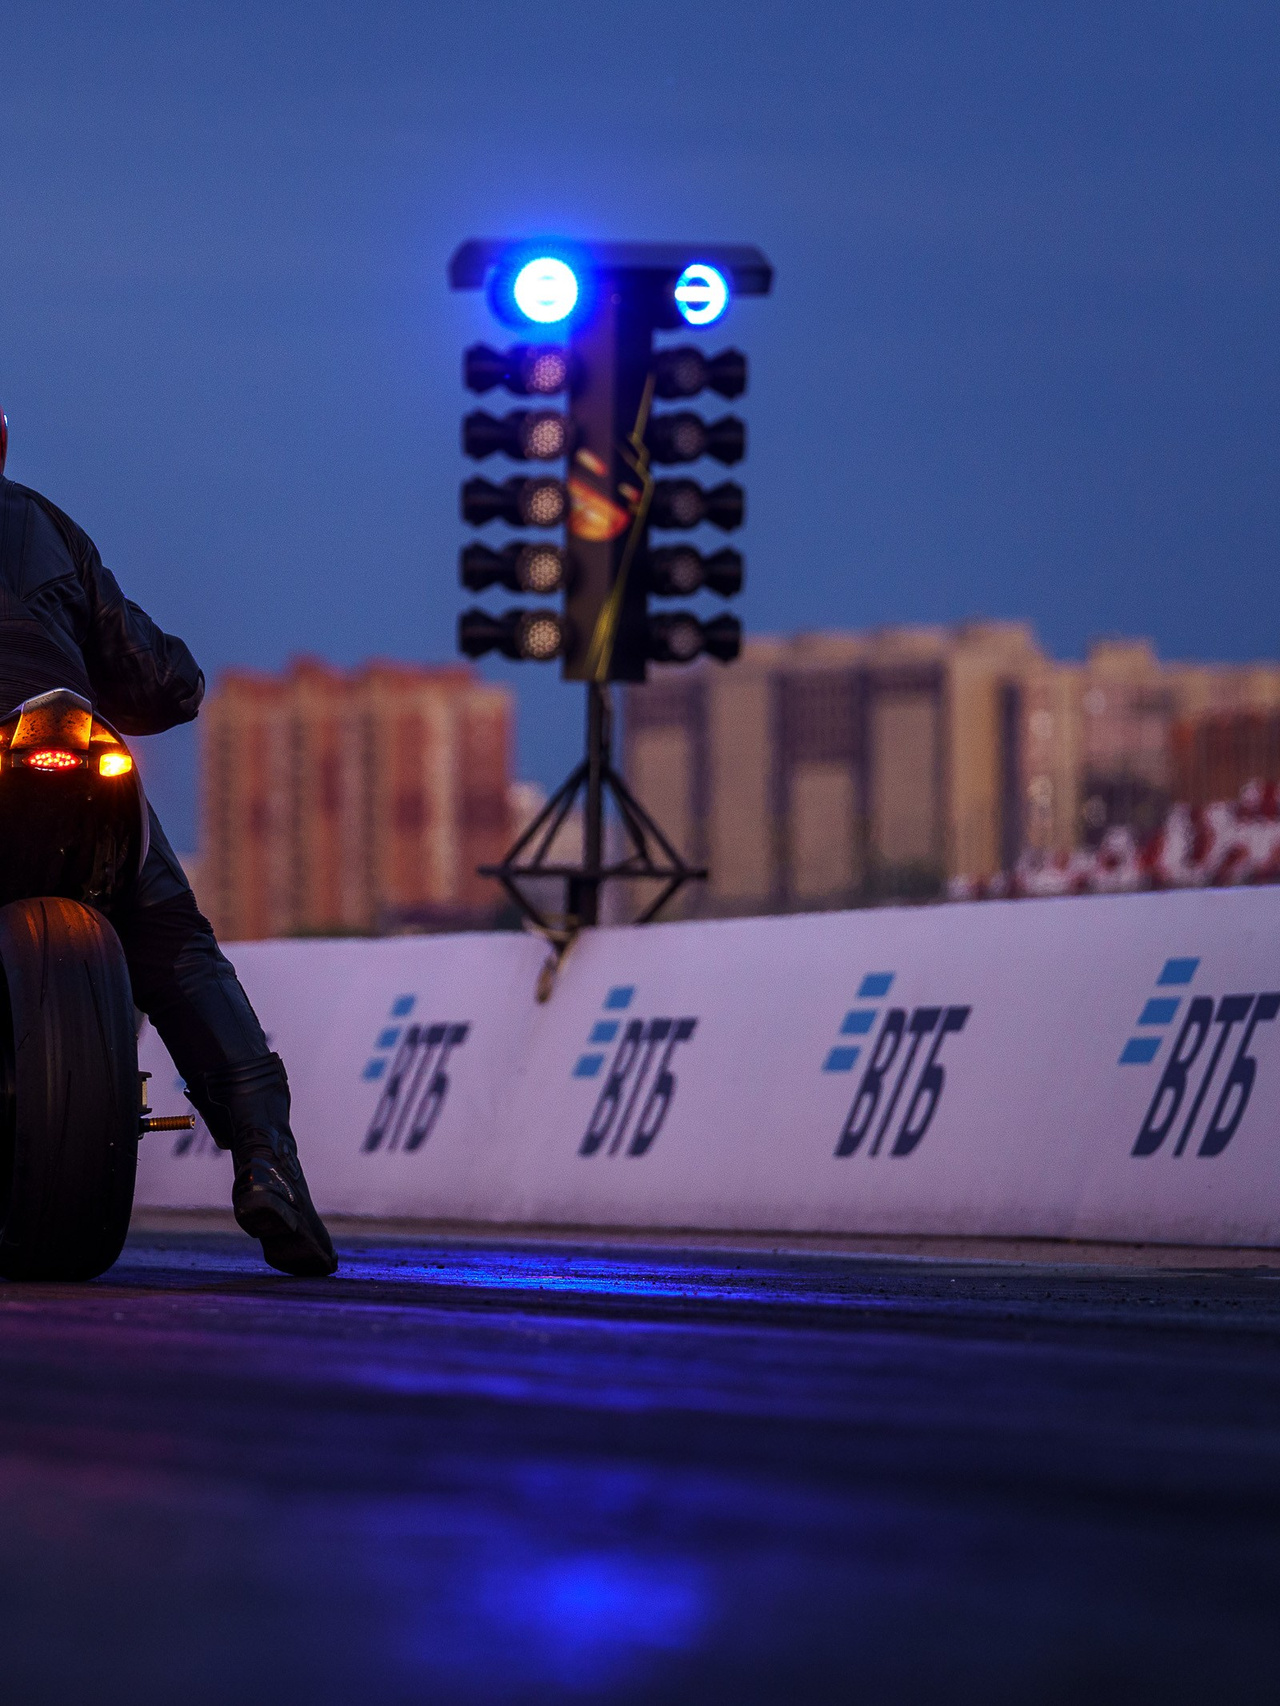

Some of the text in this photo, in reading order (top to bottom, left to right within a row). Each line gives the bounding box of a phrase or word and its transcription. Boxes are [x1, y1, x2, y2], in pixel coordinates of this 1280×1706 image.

[361, 1022, 470, 1155] ВТБ
[578, 1017, 698, 1157] ВТБ
[834, 1006, 972, 1158] ВТБ
[1130, 991, 1280, 1158] ВТБ
